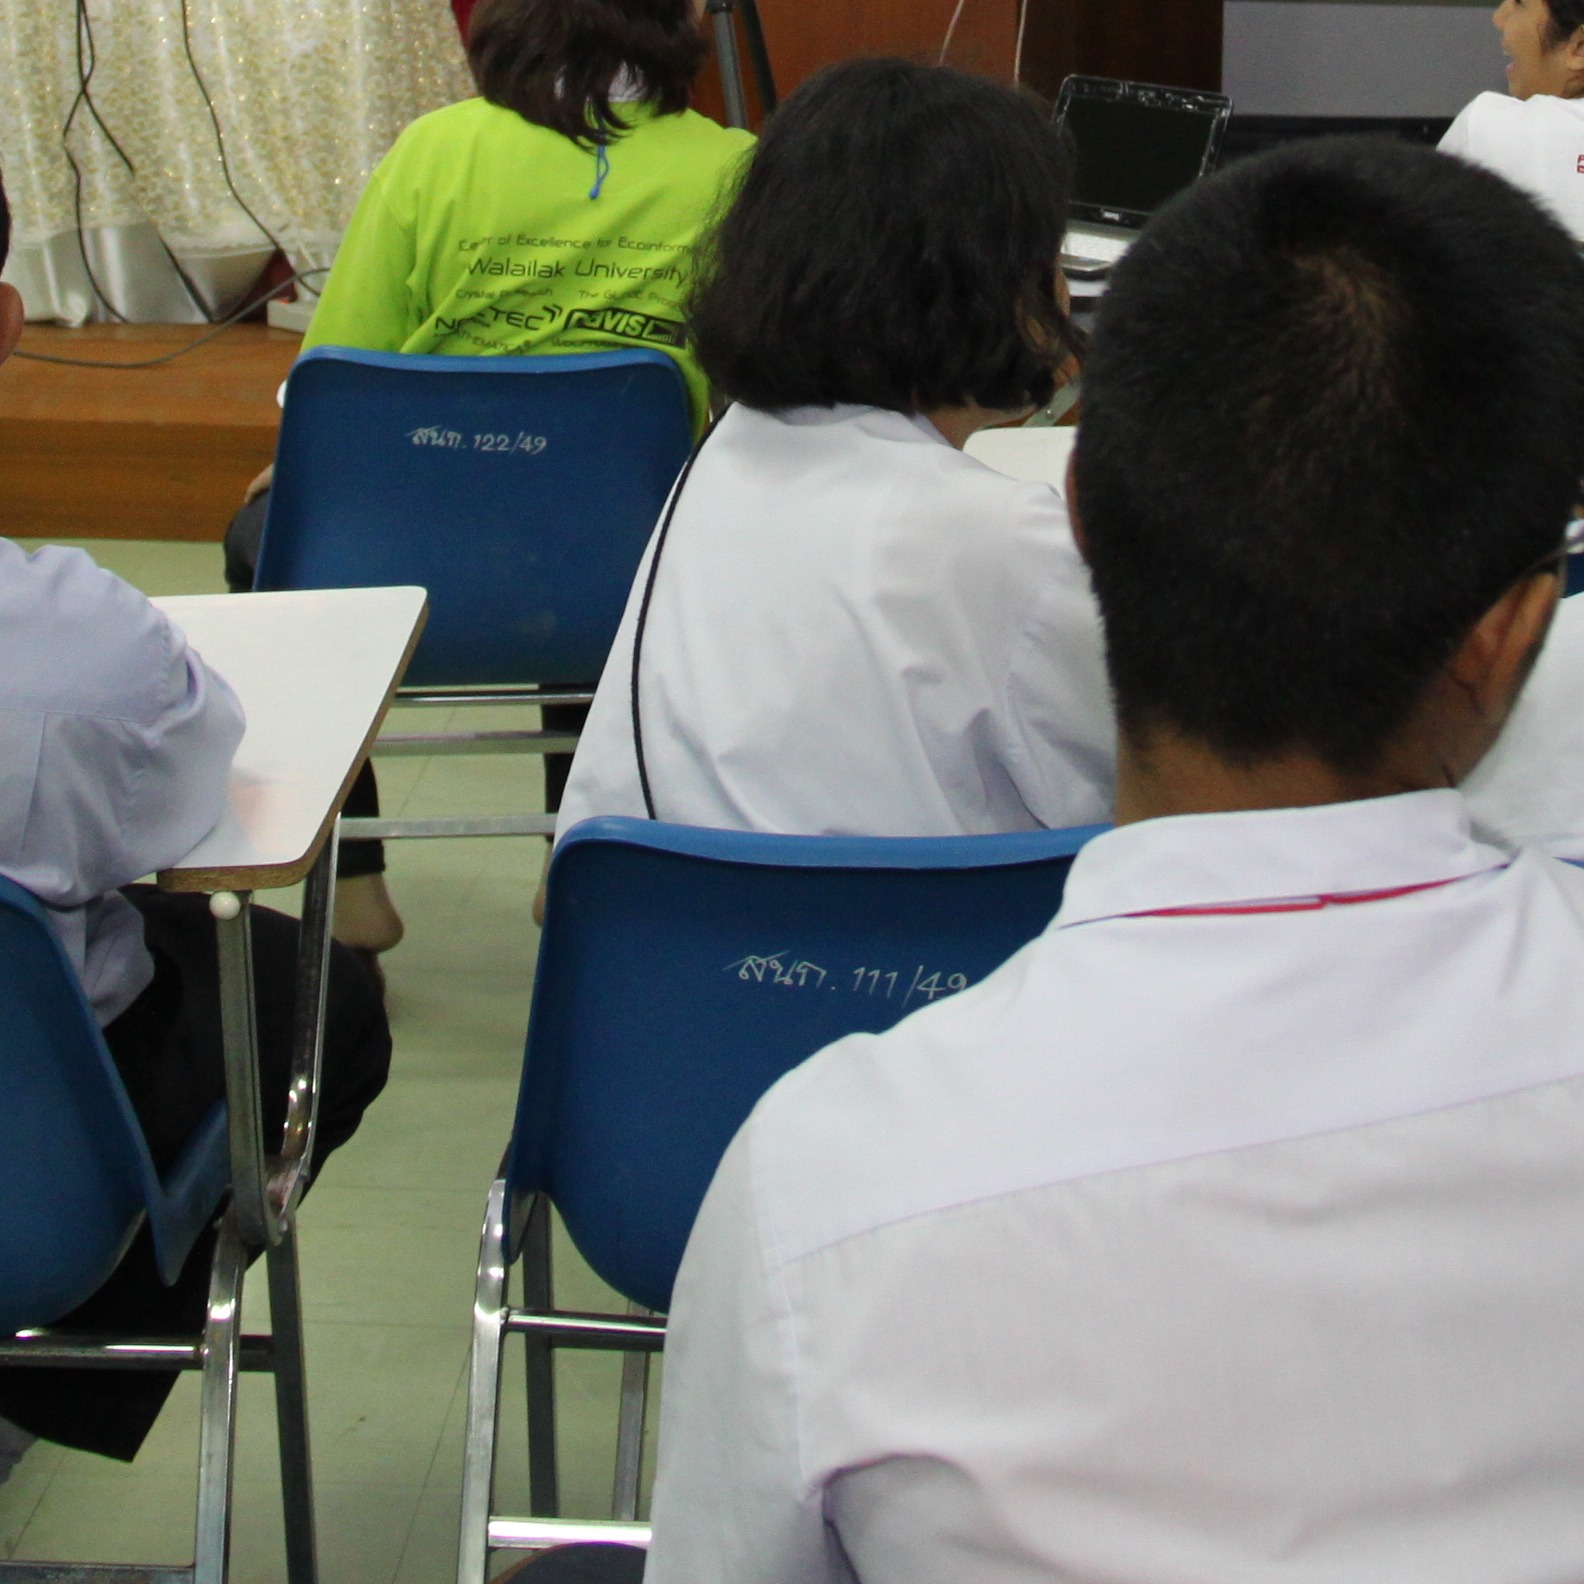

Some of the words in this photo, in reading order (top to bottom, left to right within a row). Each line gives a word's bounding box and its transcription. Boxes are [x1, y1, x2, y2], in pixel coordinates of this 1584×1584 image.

[516, 234, 591, 250] Excellence
[469, 257, 565, 279] Walailak
[575, 257, 689, 288] University
[473, 430, 548, 456] 122/49
[853, 965, 969, 1009] 111/49
